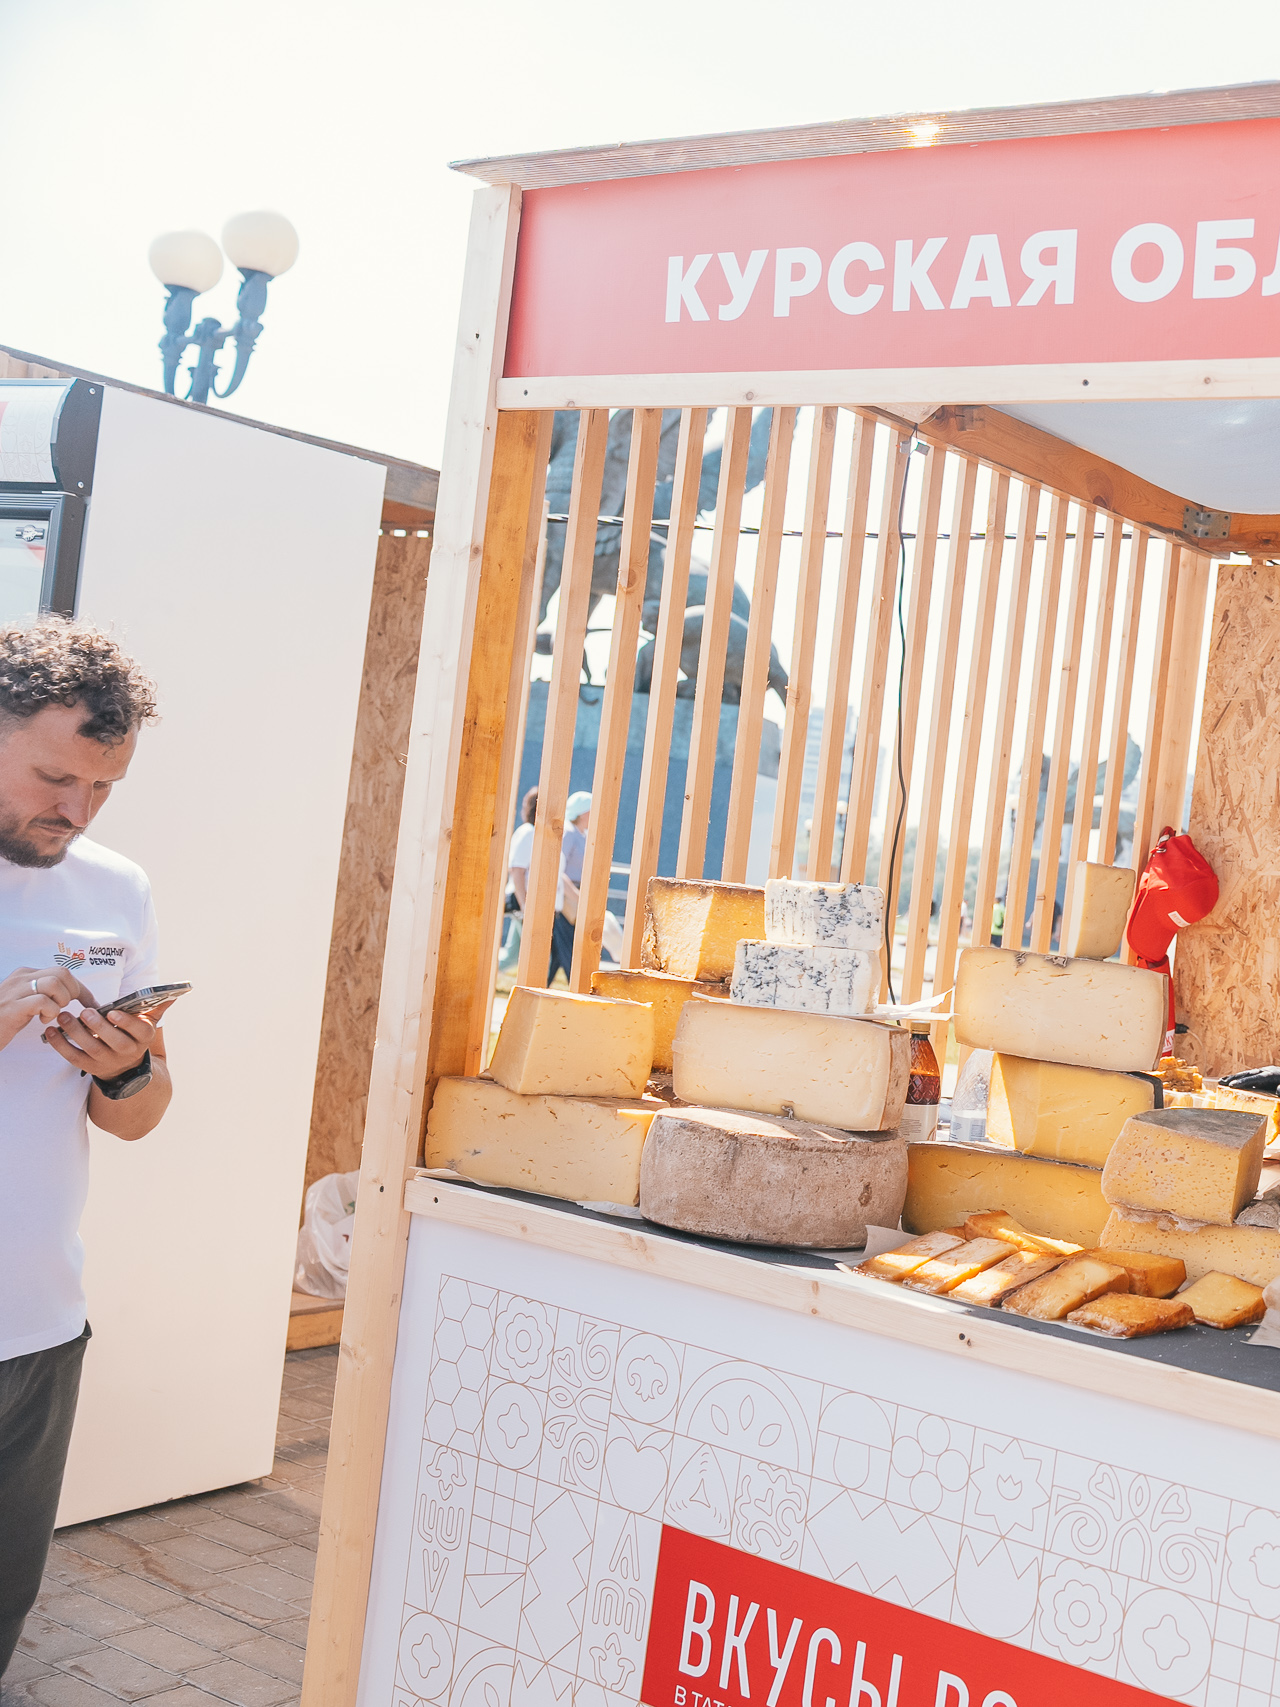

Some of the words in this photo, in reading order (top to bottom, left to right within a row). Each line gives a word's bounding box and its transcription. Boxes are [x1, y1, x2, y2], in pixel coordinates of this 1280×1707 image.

[664, 228, 1078, 323] КУРСКАЯ
[678, 1579, 903, 1707] ВКУСЫ
[674, 1684, 687, 1706] В
